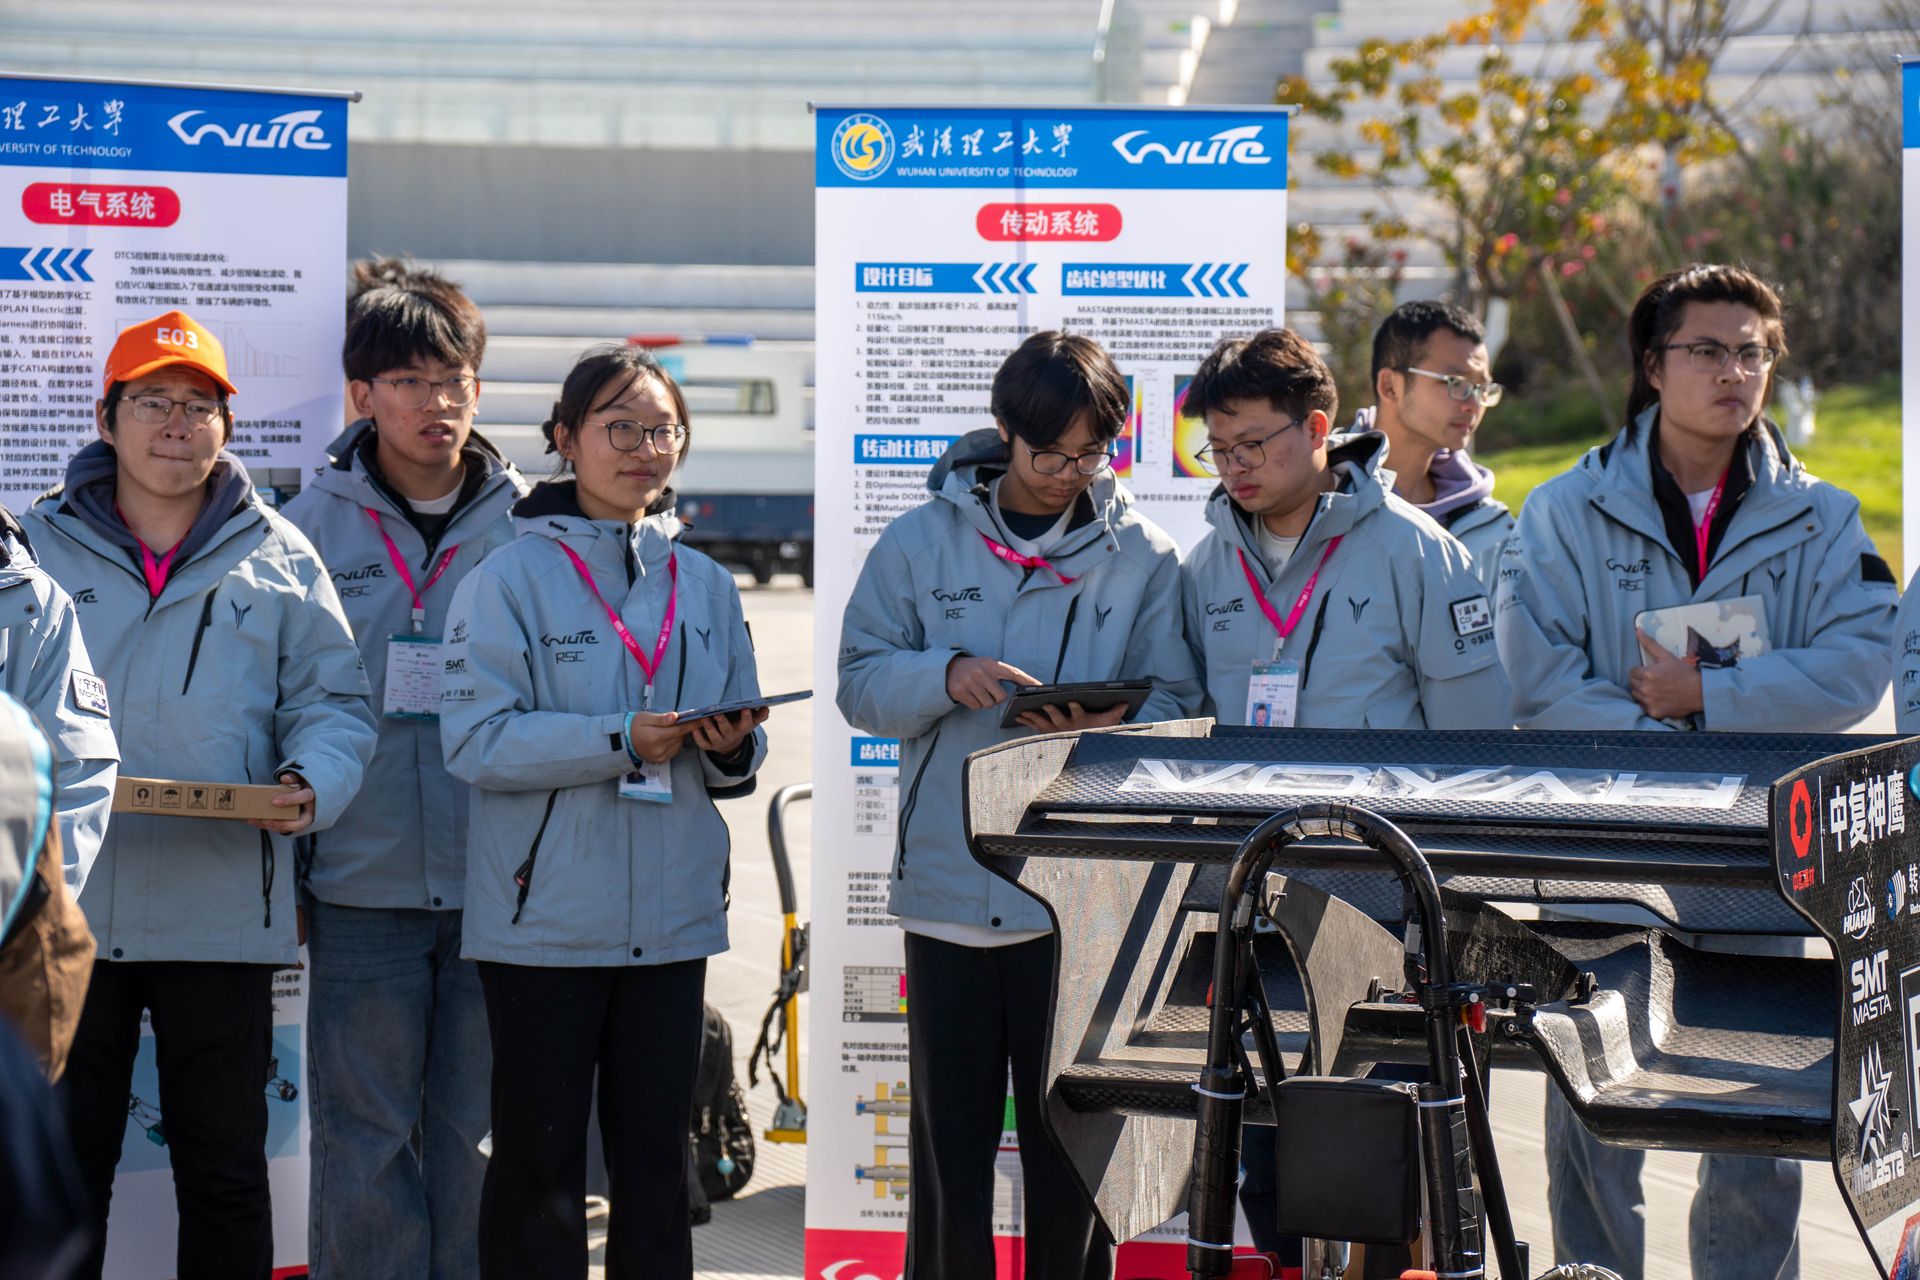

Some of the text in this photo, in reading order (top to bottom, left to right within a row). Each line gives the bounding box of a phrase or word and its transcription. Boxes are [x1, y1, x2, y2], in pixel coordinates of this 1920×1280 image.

[43, 144, 58, 155] OF
[61, 144, 132, 158] TECHNOLOGY
[896, 167, 1078, 177] WUHAN UNIVERSITY OF TECHNOLOGY
[50, 189, 156, 219] 电气系统
[1000, 210, 1100, 238] 传动系统
[863, 267, 934, 287] 设计目标
[1066, 269, 1167, 289] 齿轮修型优化
[157, 327, 199, 350] E03
[862, 439, 949, 458] 传动比选取
[1499, 569, 1521, 578] MT
[340, 585, 371, 599] RSC
[445, 659, 465, 670] SMT
[556, 651, 586, 664] RSC
[1138, 758, 1743, 809] VOYAH
[1830, 769, 1906, 852] 中复神鹰
[1843, 906, 1876, 935] HUAHAI
[1851, 949, 1889, 1004] SMT
[1853, 993, 1892, 1027] MASTA
